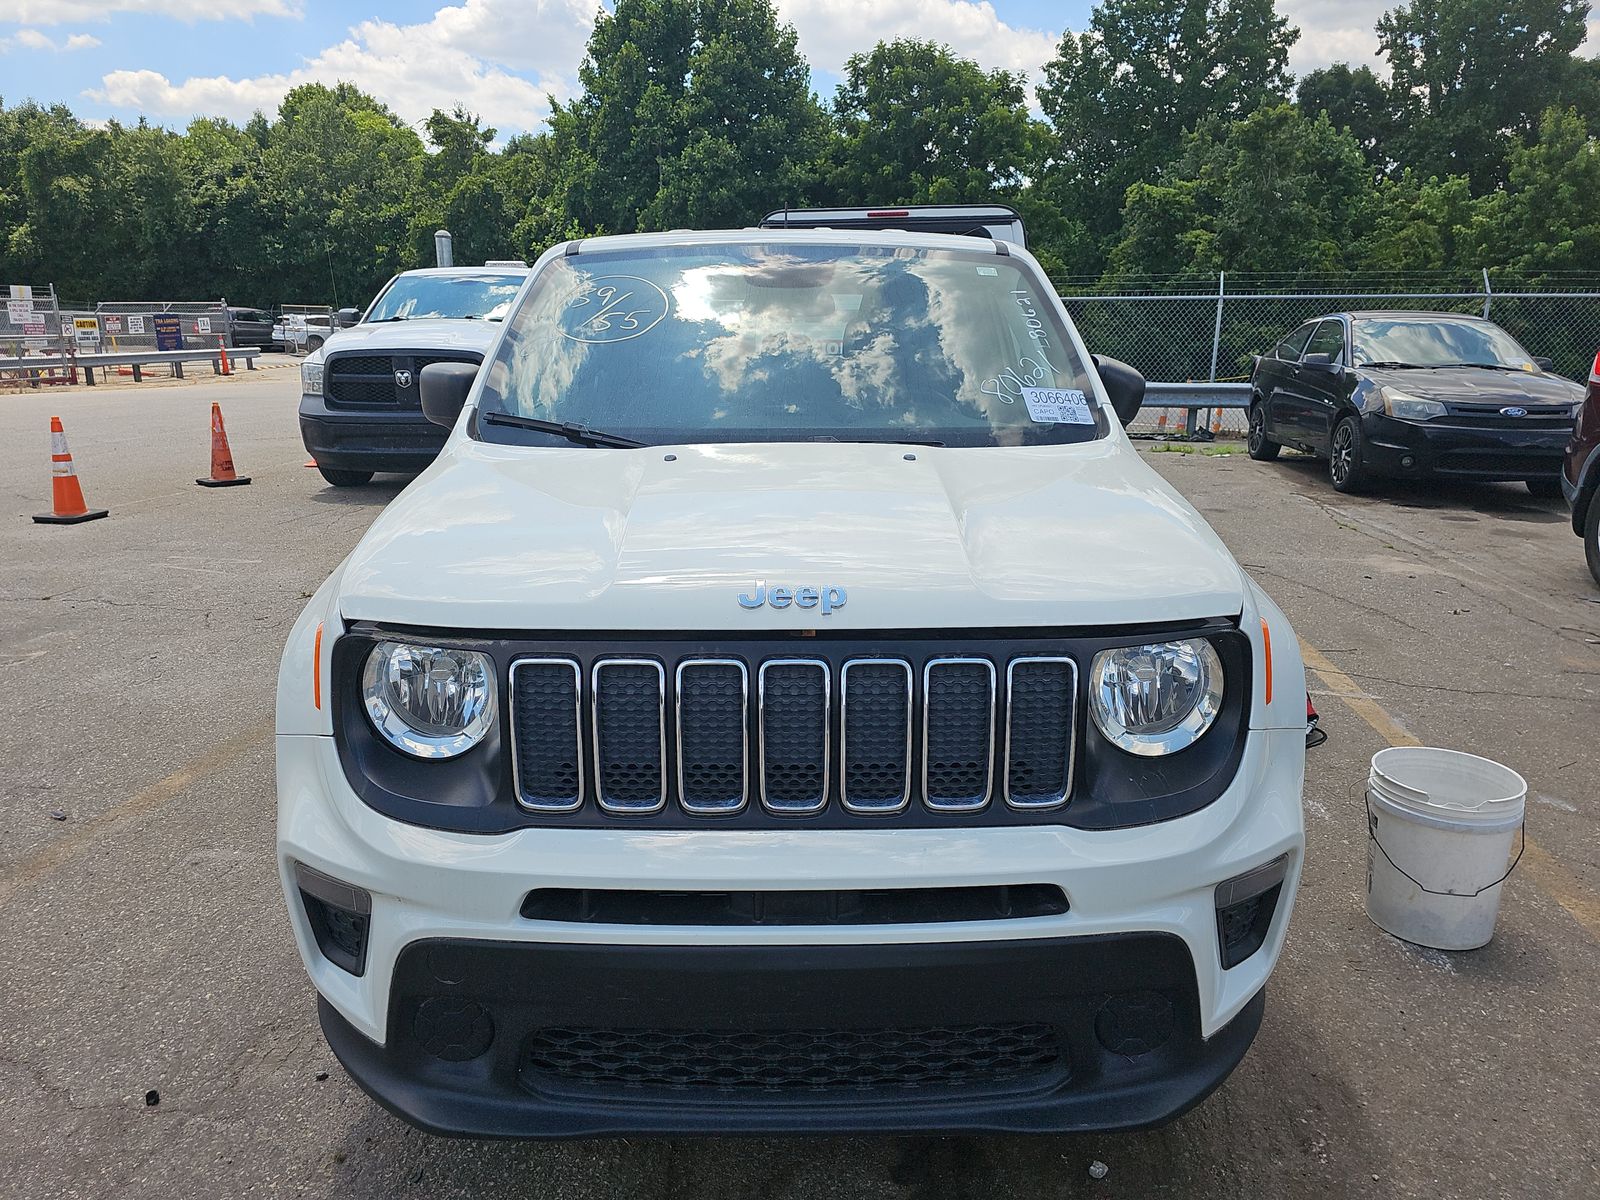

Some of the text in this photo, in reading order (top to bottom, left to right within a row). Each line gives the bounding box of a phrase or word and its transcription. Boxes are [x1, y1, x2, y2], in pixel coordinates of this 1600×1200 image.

[76, 320, 97, 328] CAUTION
[1030, 391, 1089, 406] 3066406
[737, 578, 848, 616] Jeep
